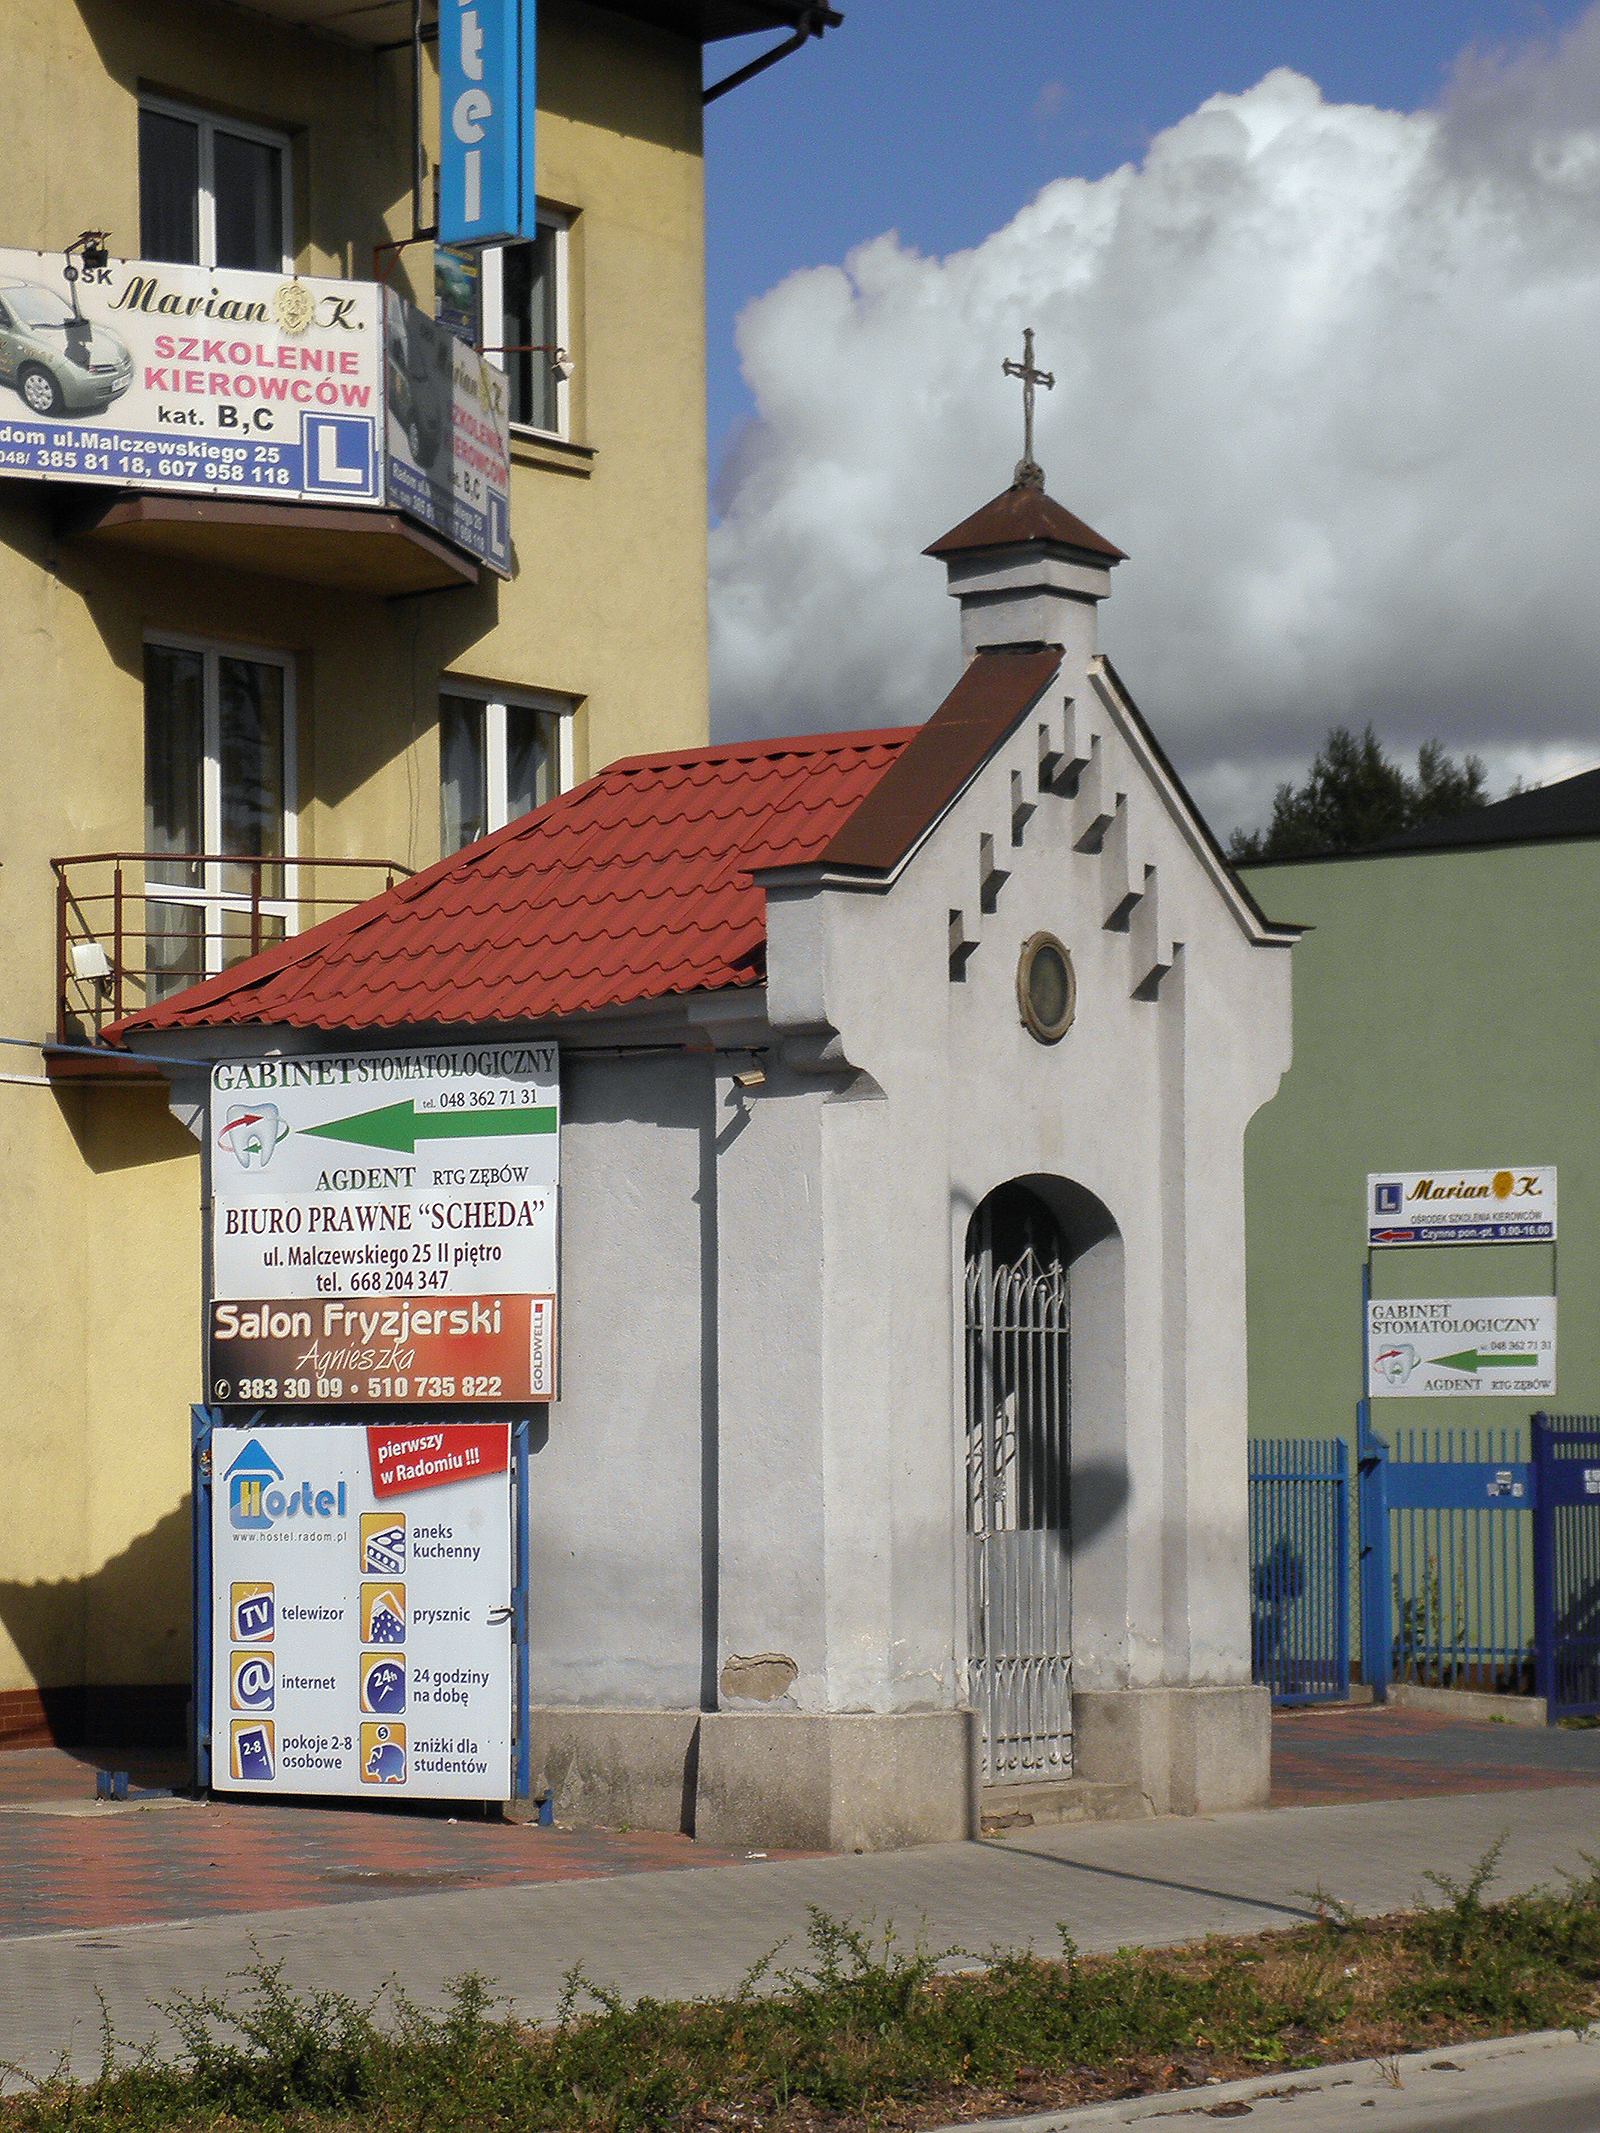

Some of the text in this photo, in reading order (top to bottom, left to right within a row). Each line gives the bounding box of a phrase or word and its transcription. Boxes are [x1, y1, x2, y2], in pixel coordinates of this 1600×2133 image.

[452, 0, 492, 223] tel
[108, 276, 365, 330] Marian K.
[154, 335, 359, 375] SZKOLENIE
[144, 367, 371, 407] KIEROWCÓW
[158, 405, 273, 434] kat. B,C
[0, 426, 280, 463] dom ul.Malczewskiego 25
[318, 425, 363, 484] L
[37, 450, 78, 468] 385
[84, 453, 109, 471] 81
[119, 456, 152, 477] 18,
[158, 459, 198, 478] 607
[204, 463, 244, 481] 958
[251, 466, 290, 485] 118
[213, 1049, 555, 1091] GABINET STOMATOLOGICZNY
[423, 1088, 537, 1108] tel. 048 362 71 31
[315, 1164, 529, 1191] AGDENT RTG ZĘBÓW
[1406, 1176, 1542, 1200] Marian K.
[1381, 1189, 1396, 1209] L
[225, 1207, 301, 1235] BIURO
[308, 1204, 412, 1233] PRAWNE
[264, 1247, 284, 1266] ul.
[288, 1244, 408, 1269] Malczewskiego
[412, 1243, 431, 1263] 25
[454, 1242, 501, 1267] piętro
[317, 1270, 448, 1292] tel. 668 204 347
[214, 1300, 501, 1344] Salon Fryzjerski
[1372, 1304, 1452, 1319] GABINET
[1372, 1318, 1539, 1334] STOMATOLOGICZNY
[295, 1338, 416, 1379] Agnieszka
[533, 1313, 543, 1390] GOLDWELL
[239, 1376, 502, 1399] 383 30 09 510 735 822
[1424, 1378, 1483, 1391] AGDENT
[378, 1433, 444, 1463] pierwszy
[380, 1447, 480, 1484] w Radomiu !!!
[240, 1481, 346, 1518] Hostel
[232, 1531, 347, 1542] www.hostel.radom.pl
[413, 1524, 453, 1539] aneks
[413, 1543, 480, 1562] kuchenny
[242, 1601, 268, 1628] TV
[282, 1606, 344, 1620] telewizor
[413, 1607, 470, 1623] prysznic
[282, 1675, 336, 1689] internet
[373, 1669, 398, 1688] 24h
[413, 1669, 489, 1687] 24 godziny
[413, 1688, 469, 1707] na dobę
[243, 1739, 262, 1756] 2-8
[282, 1734, 352, 1752] pokoje 2-8
[413, 1738, 478, 1753] zniżki dla
[282, 1753, 342, 1769] osobowe
[414, 1758, 487, 1773] studentów
